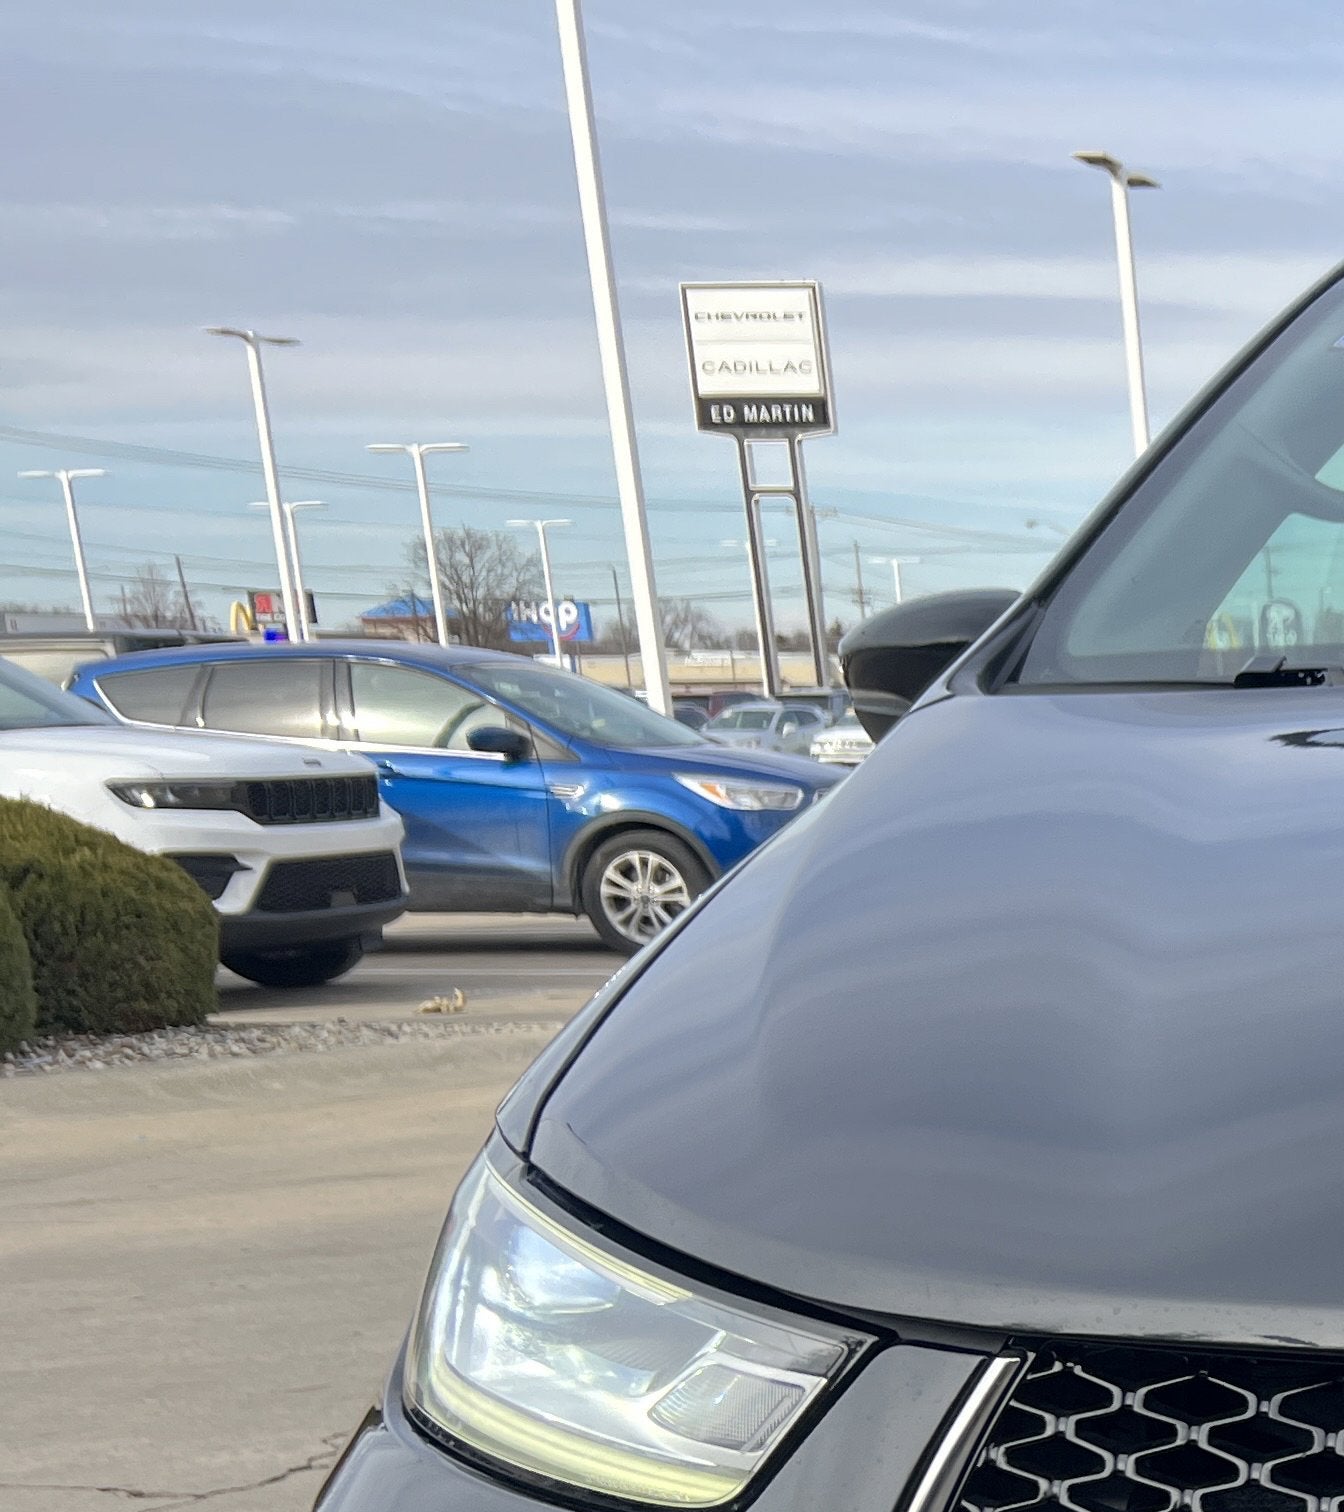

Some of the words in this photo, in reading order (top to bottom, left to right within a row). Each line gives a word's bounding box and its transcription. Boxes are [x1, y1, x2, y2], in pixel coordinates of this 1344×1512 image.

[694, 311, 806, 321] CHEVROLET
[701, 359, 813, 375] CADILLAC
[710, 404, 736, 423] ED
[743, 403, 815, 423] MARTIN
